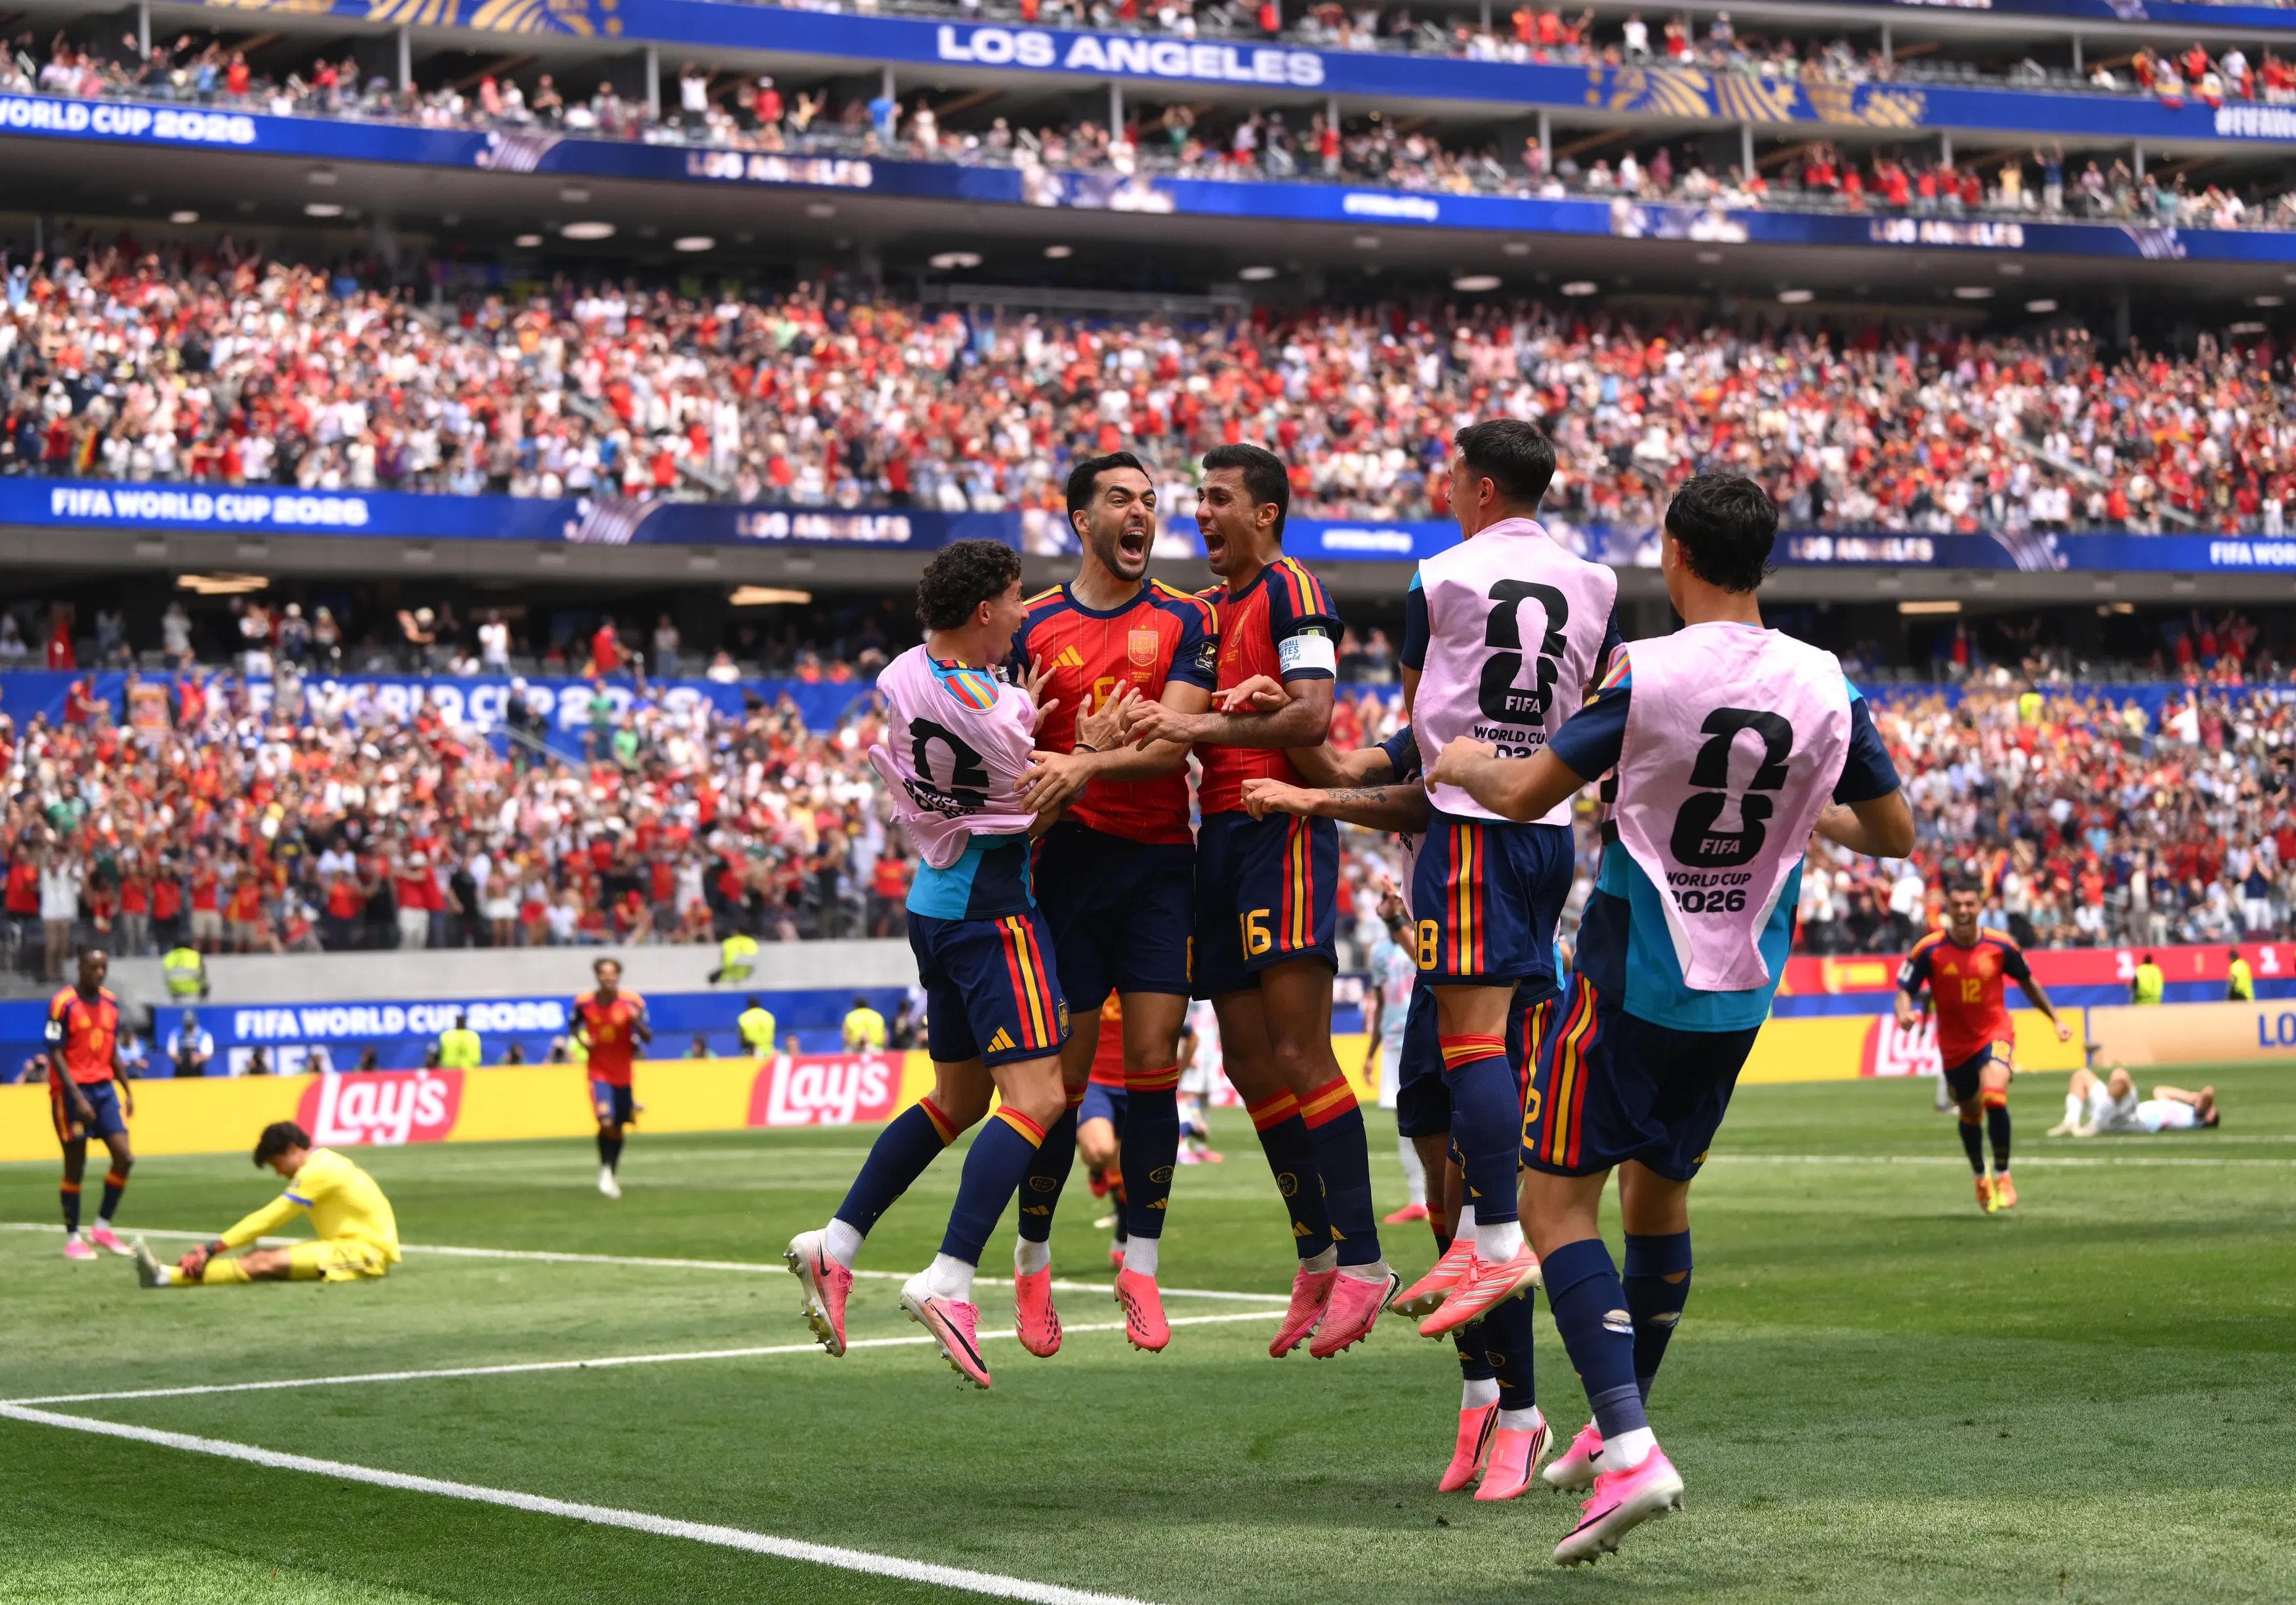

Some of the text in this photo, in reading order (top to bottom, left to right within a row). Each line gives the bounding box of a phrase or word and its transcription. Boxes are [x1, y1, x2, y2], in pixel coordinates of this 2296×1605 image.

[937, 25, 1326, 87] LOS ANGELES
[91, 104, 152, 136] CUP
[51, 488, 113, 517] FIFA
[114, 490, 214, 522] WORLD
[215, 493, 272, 522] CUP
[2209, 540, 2253, 566] FIFA
[1504, 695, 1542, 713] FIFA
[1473, 725, 1548, 745] WORLD CU
[1699, 839, 1740, 854] FIFA
[1665, 871, 1752, 887] WORLD CUP
[1239, 909, 1271, 961] 16
[1961, 978, 1982, 1003] 12
[234, 1009, 300, 1039] FIFA
[300, 1006, 407, 1037] WORLD
[407, 1004, 464, 1034] CUP
[2258, 1012, 2296, 1049] LO
[1874, 1014, 1940, 1076] Lay
[766, 1053, 890, 1125] Lay's
[313, 1068, 448, 1147] Lay's
